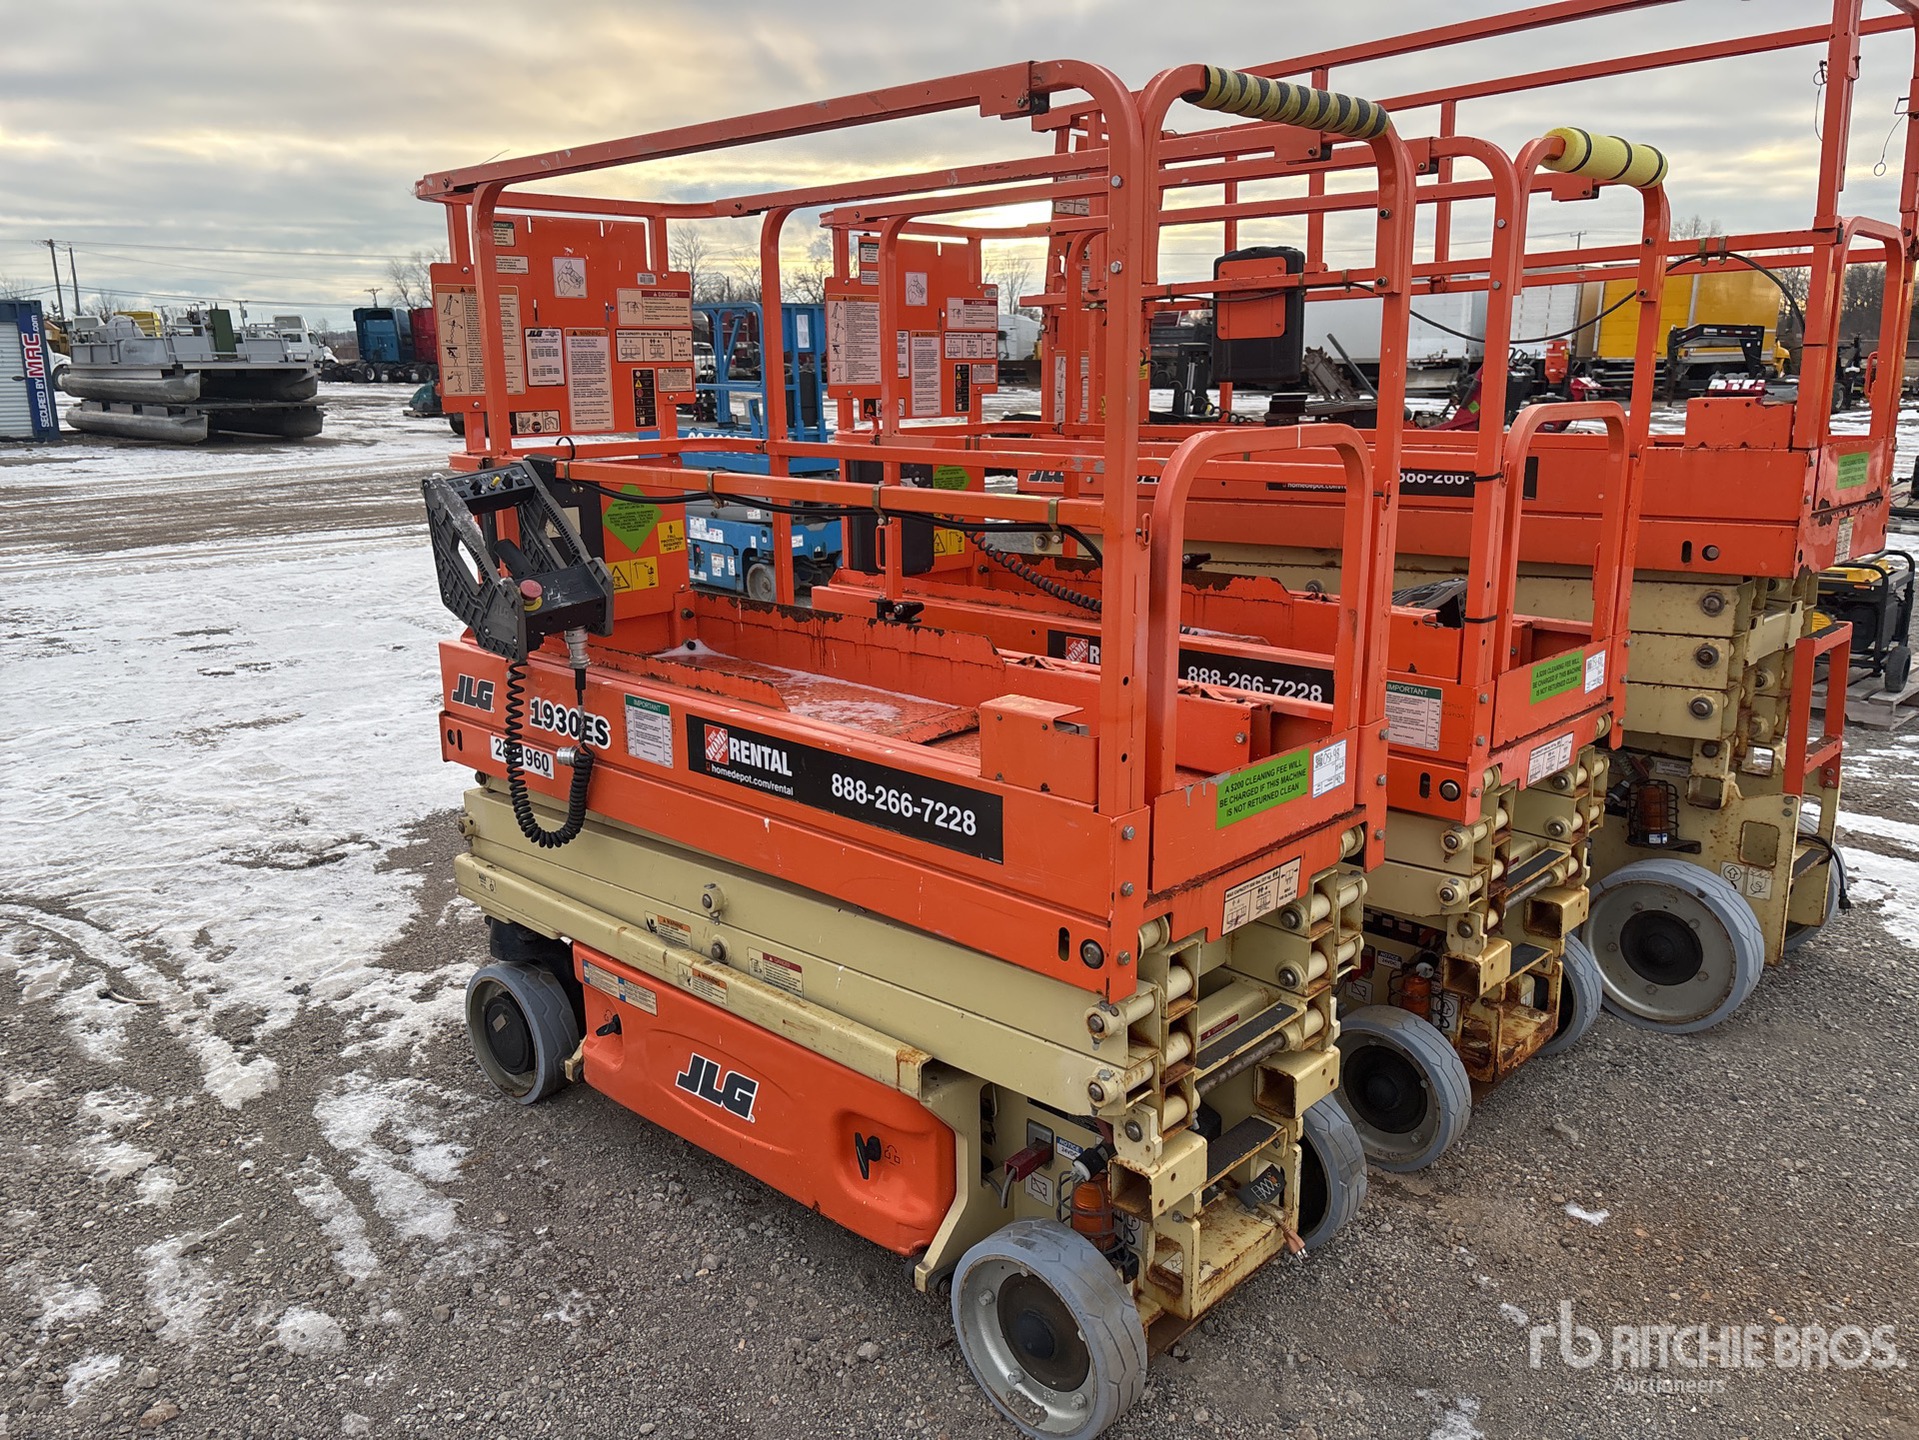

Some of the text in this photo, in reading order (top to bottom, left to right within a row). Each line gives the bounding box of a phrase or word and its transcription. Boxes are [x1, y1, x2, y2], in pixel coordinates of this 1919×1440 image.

[35, 378, 44, 390] BY
[37, 390, 50, 428] SECURED
[451, 673, 495, 713] JLG
[1187, 666, 1322, 703] 888-266-7228
[1387, 684, 1428, 695] IMPORTANT
[633, 699, 661, 711] IMPORTANT
[530, 696, 611, 749] 1930ES
[706, 728, 728, 760] HOME
[729, 737, 793, 777] RENTAL
[711, 764, 794, 796] homedepot.com/rental
[1219, 797, 1228, 808] BE
[1229, 786, 1258, 803] CHARGED
[1267, 779, 1279, 790] THIS
[1280, 768, 1306, 784] MACHINE
[1225, 760, 1302, 794] A $200 CLEANING FEE WILL
[831, 773, 977, 836] 888-266-7228
[1227, 782, 1299, 817] IS NOT RETURNED CLEAN
[666, 919, 684, 929] WARNING
[675, 1052, 759, 1120] JLG
[1060, 1139, 1080, 1151] NOTICE
[1061, 1147, 1078, 1157] 24VDC
